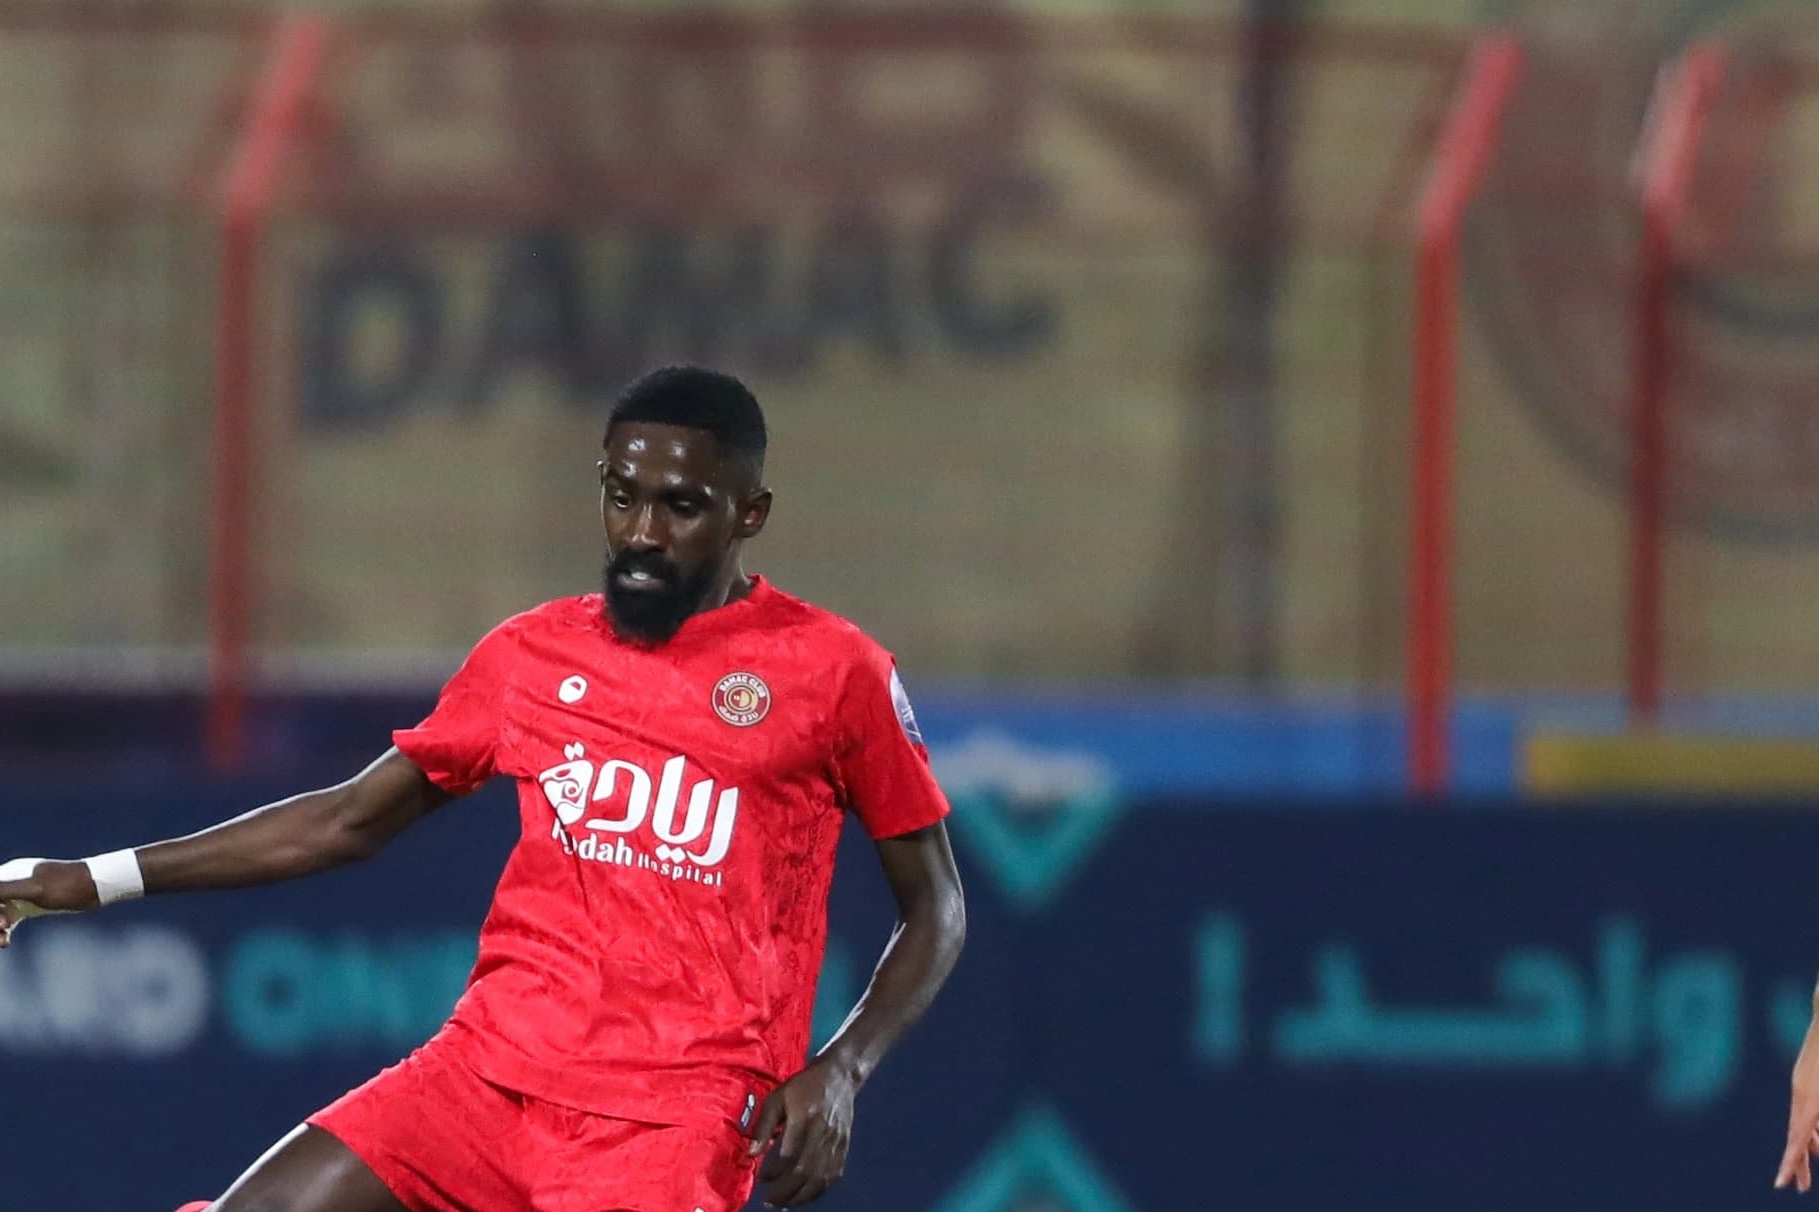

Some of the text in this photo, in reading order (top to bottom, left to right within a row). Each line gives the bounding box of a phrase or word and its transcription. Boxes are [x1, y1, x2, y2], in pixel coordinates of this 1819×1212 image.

[299, 175, 1061, 430] DAMAC
[719, 675, 767, 698] DAMAC CLUB
[538, 741, 739, 867] ريادة
